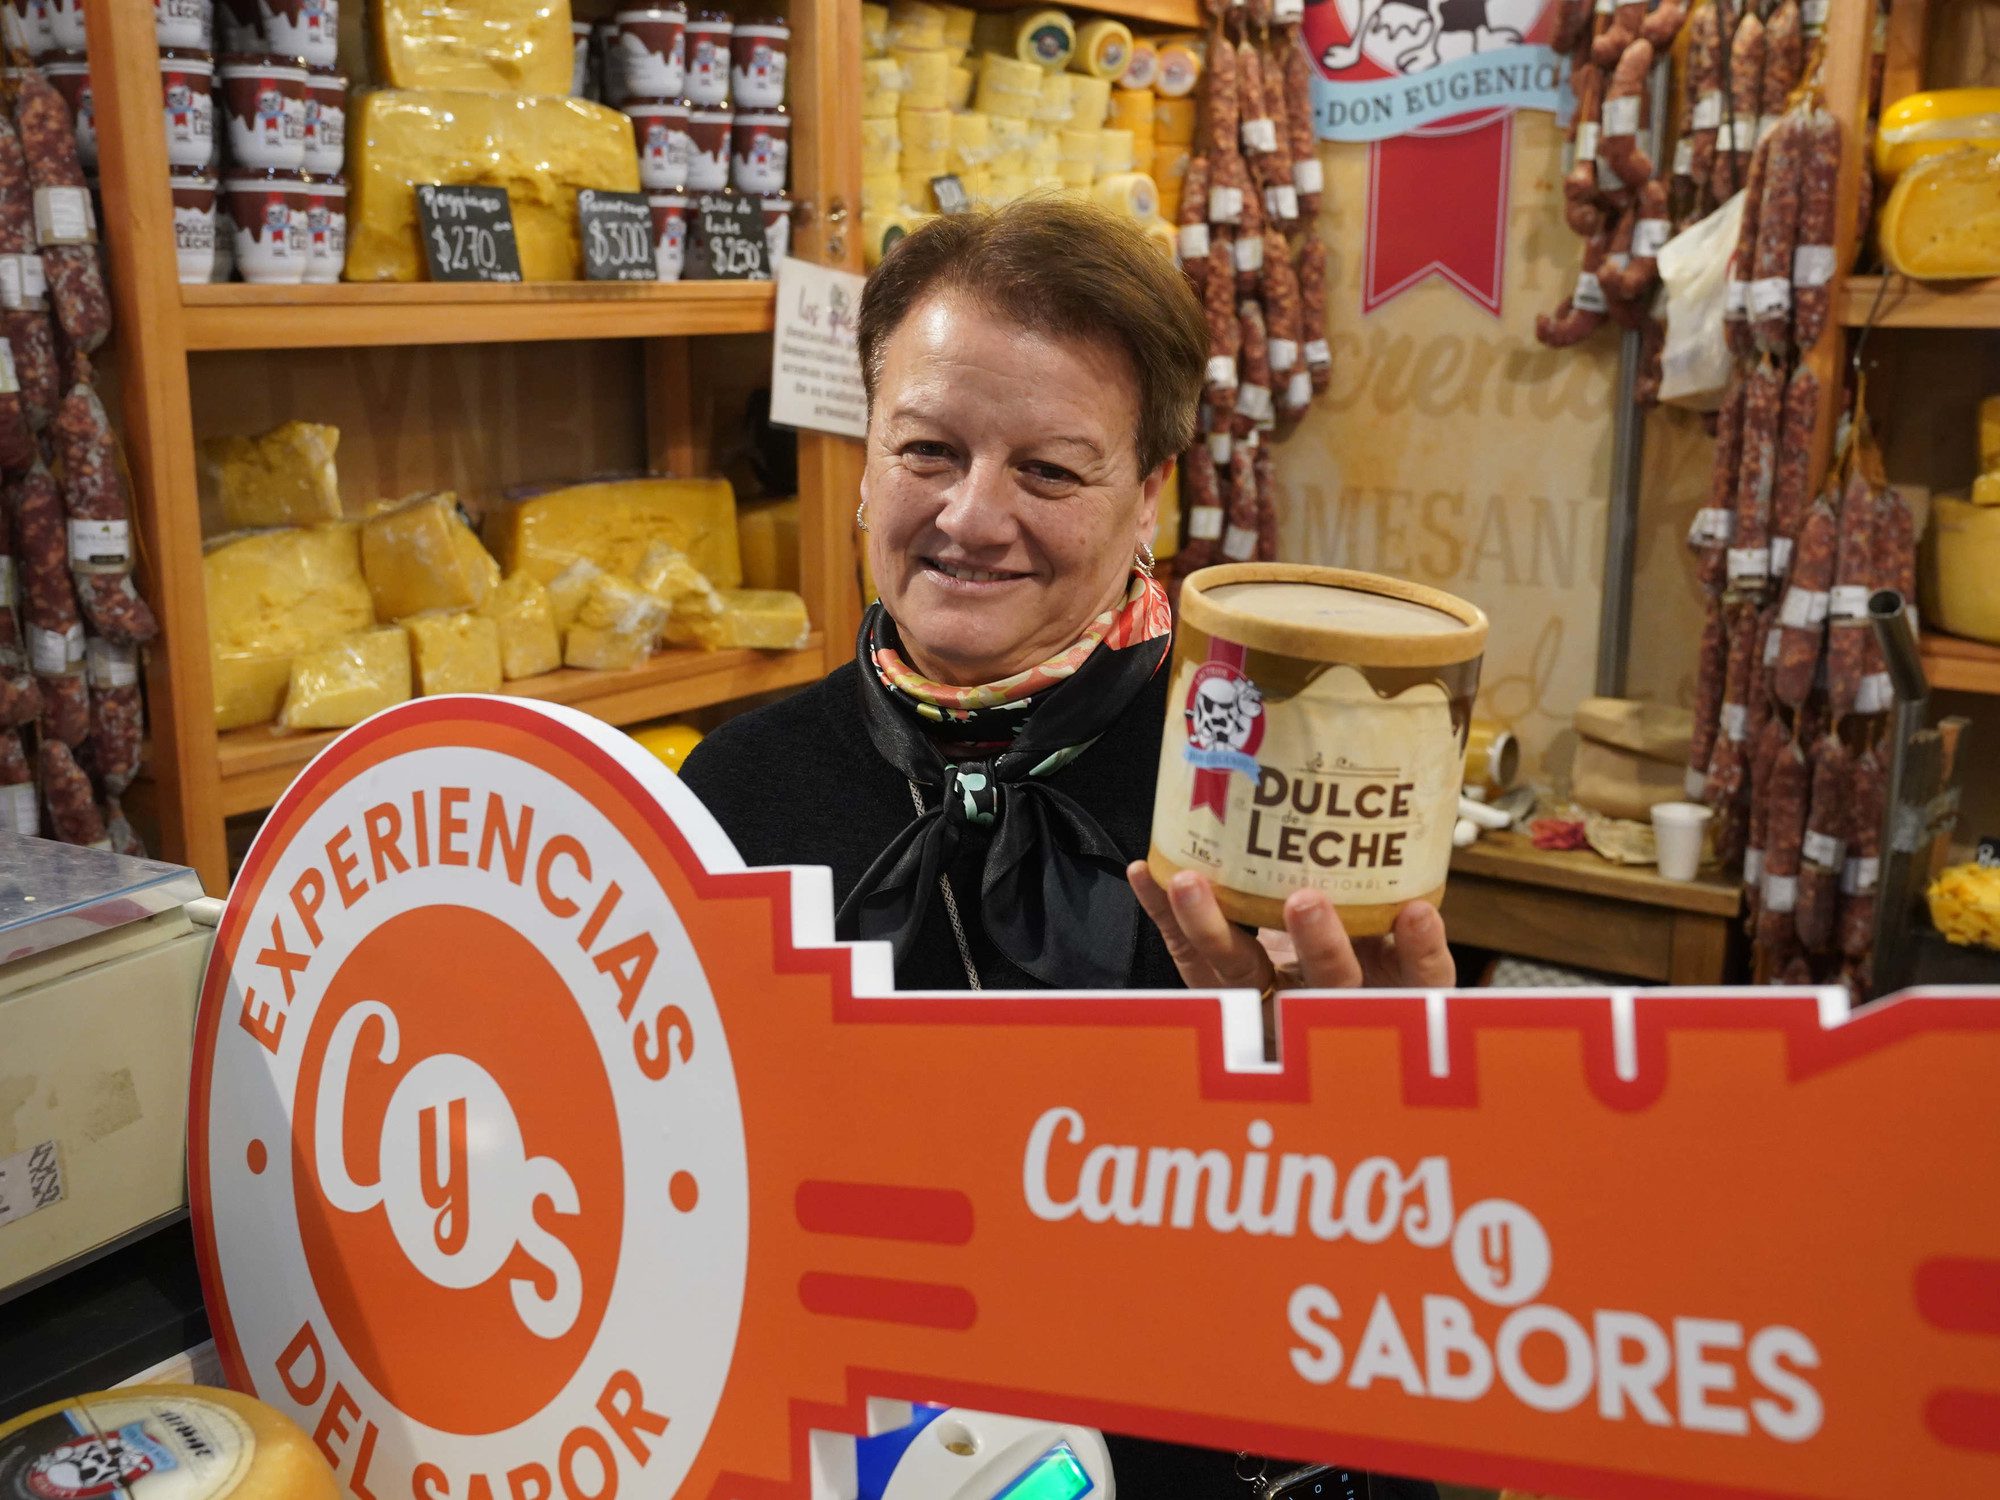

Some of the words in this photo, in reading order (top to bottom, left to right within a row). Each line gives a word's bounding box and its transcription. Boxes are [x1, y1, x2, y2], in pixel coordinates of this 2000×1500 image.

[1327, 94, 1394, 127] DON
[1404, 61, 1560, 115] EUGENIO
[1246, 809, 1407, 868] LECHE
[1254, 764, 1414, 819] DULCE
[239, 785, 695, 1083] EXPERIENCIAS
[1022, 1106, 1455, 1248] Caminos
[1477, 1211, 1514, 1288] y
[275, 1320, 378, 1500] DEL
[1288, 1283, 1824, 1442] SABORES
